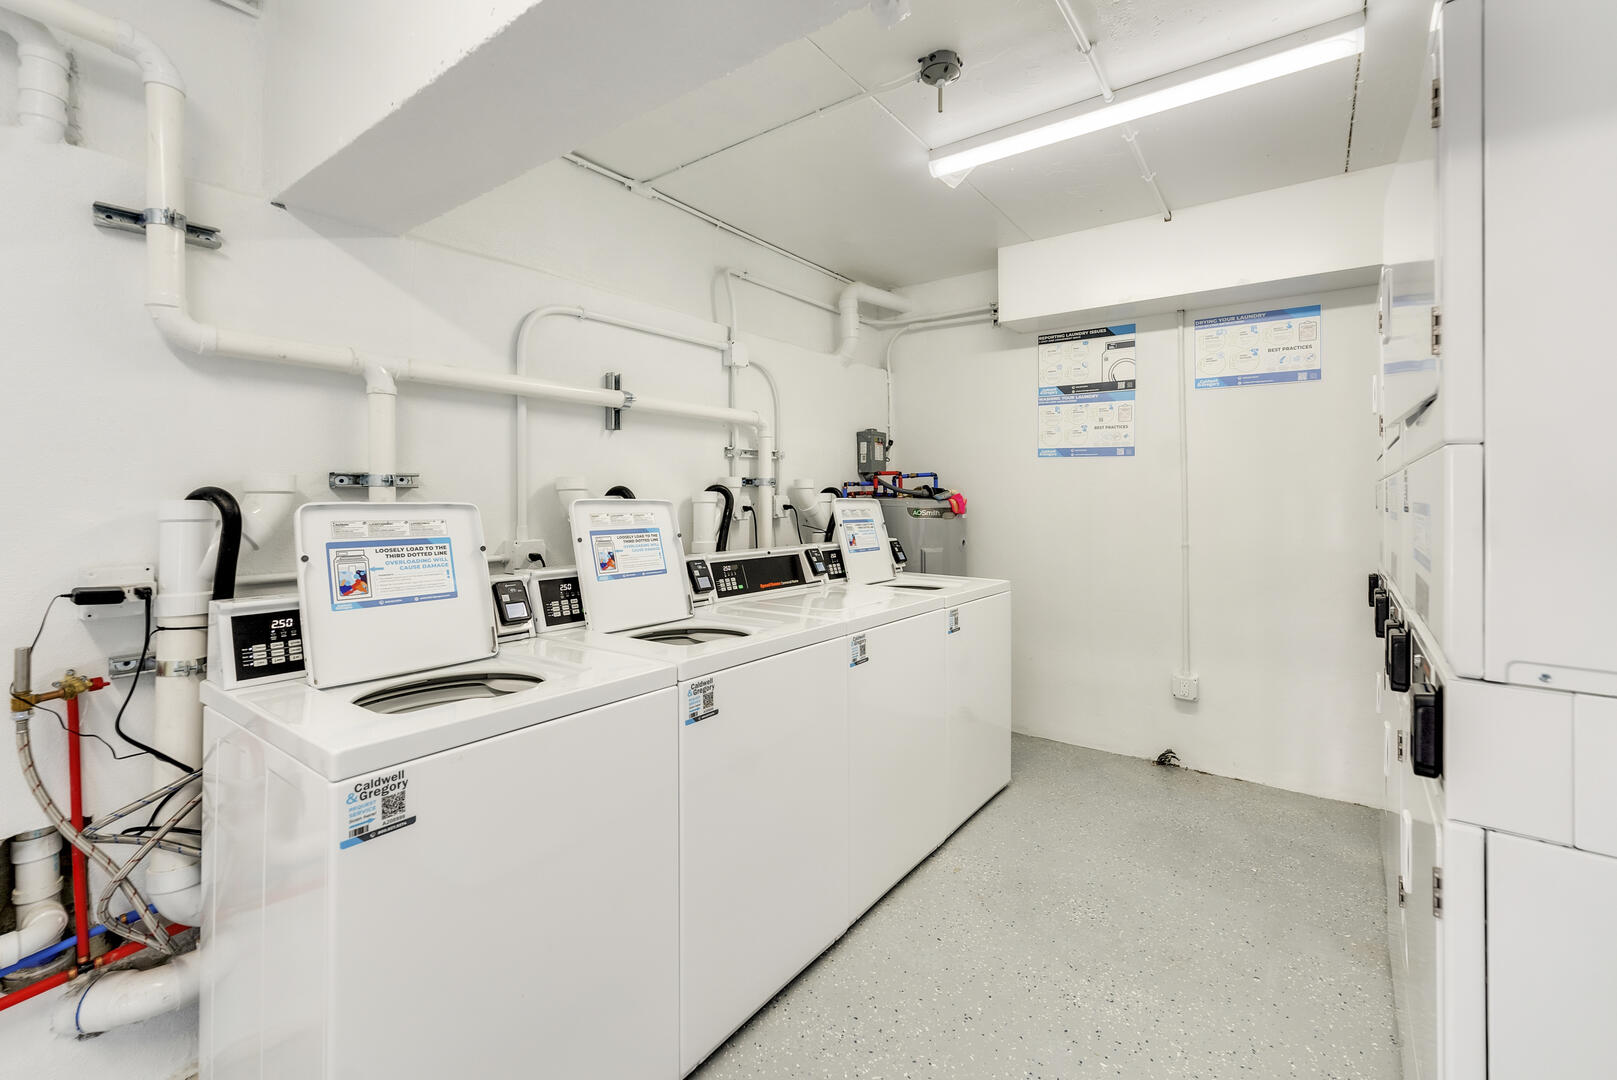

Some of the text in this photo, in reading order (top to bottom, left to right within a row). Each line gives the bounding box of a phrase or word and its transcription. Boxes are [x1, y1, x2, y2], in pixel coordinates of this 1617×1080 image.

[691, 678, 713, 690] Caldwell
[693, 684, 715, 695] Gregory
[354, 770, 404, 793] Caldwell
[346, 779, 408, 805] & Gregory
